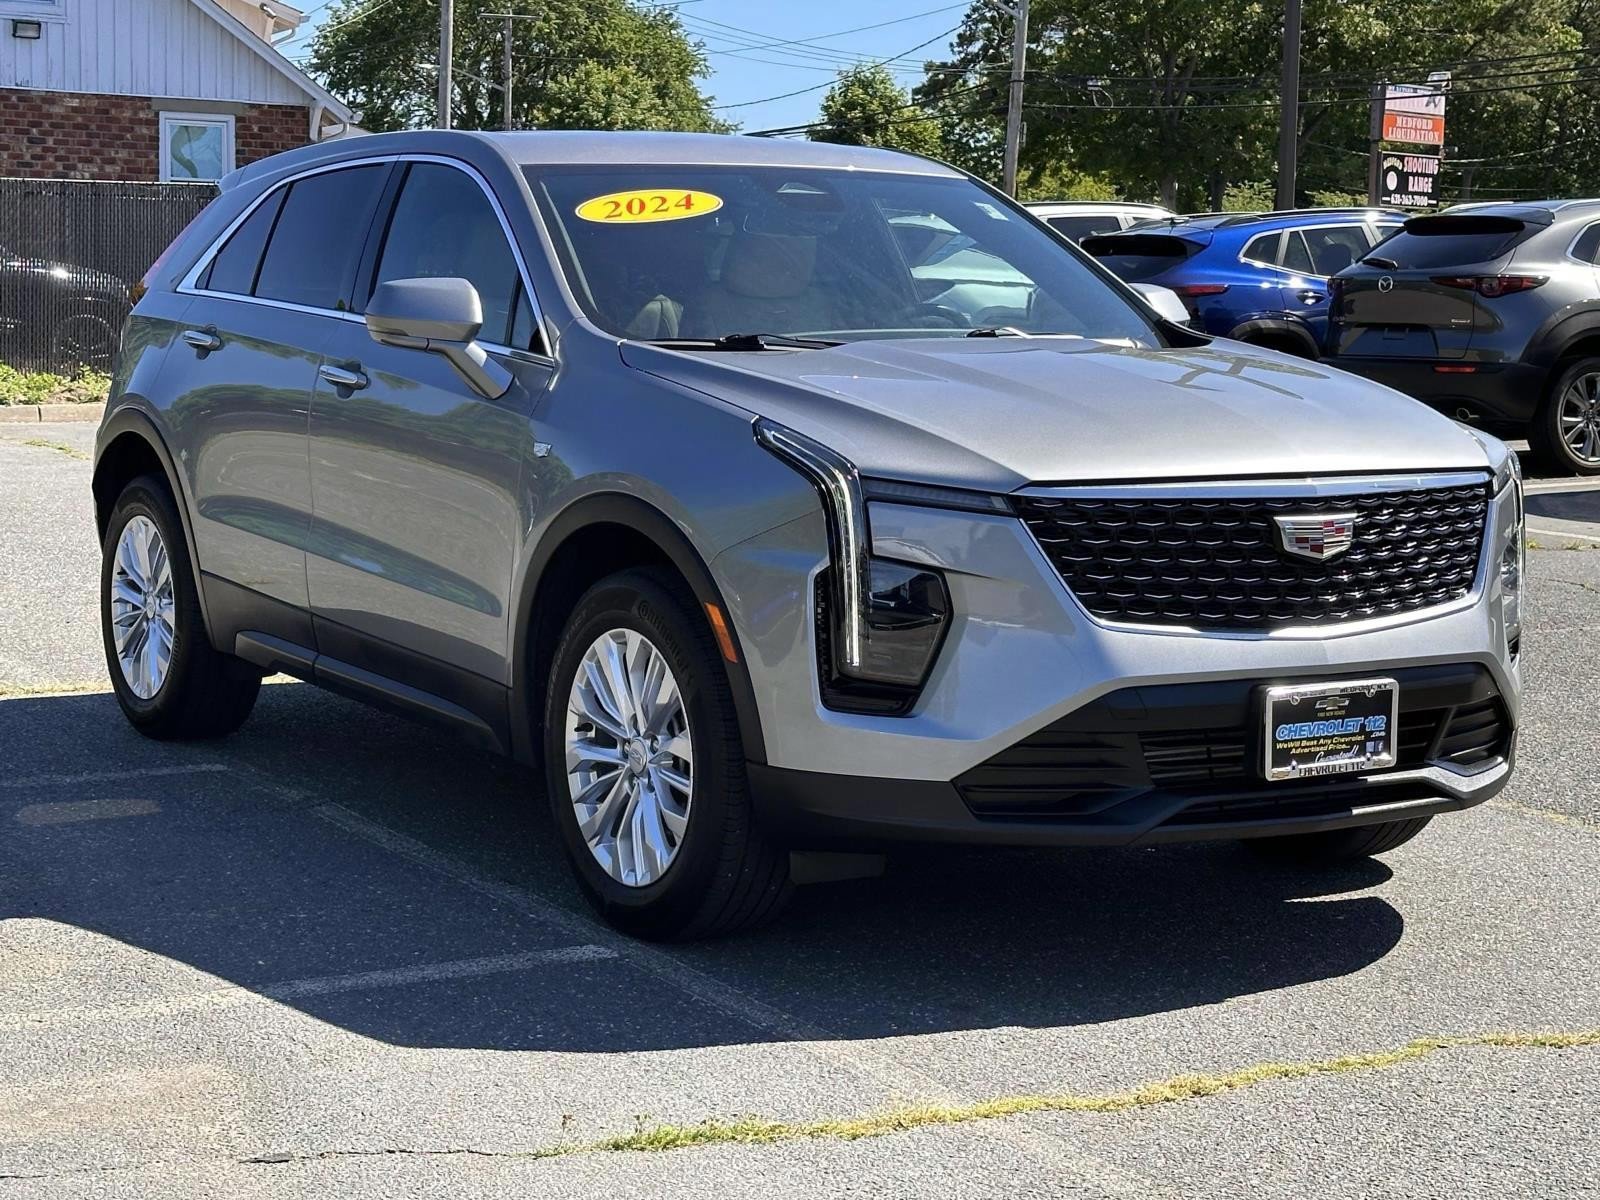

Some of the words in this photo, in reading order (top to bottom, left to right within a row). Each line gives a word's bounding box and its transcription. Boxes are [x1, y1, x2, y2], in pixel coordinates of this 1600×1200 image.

[1396, 116, 1433, 130] MEDFORD
[1388, 127, 1440, 142] LIQUIDATION
[1403, 156, 1439, 175] SHOOTING
[1408, 176, 1433, 193] RANGE
[603, 193, 695, 219] 2024
[1276, 717, 1364, 740] CHEVROLET
[1364, 715, 1387, 731] 112
[1319, 738, 1332, 747] Any
[1332, 735, 1365, 744] Chevrolet
[1290, 745, 1328, 754] Advertised
